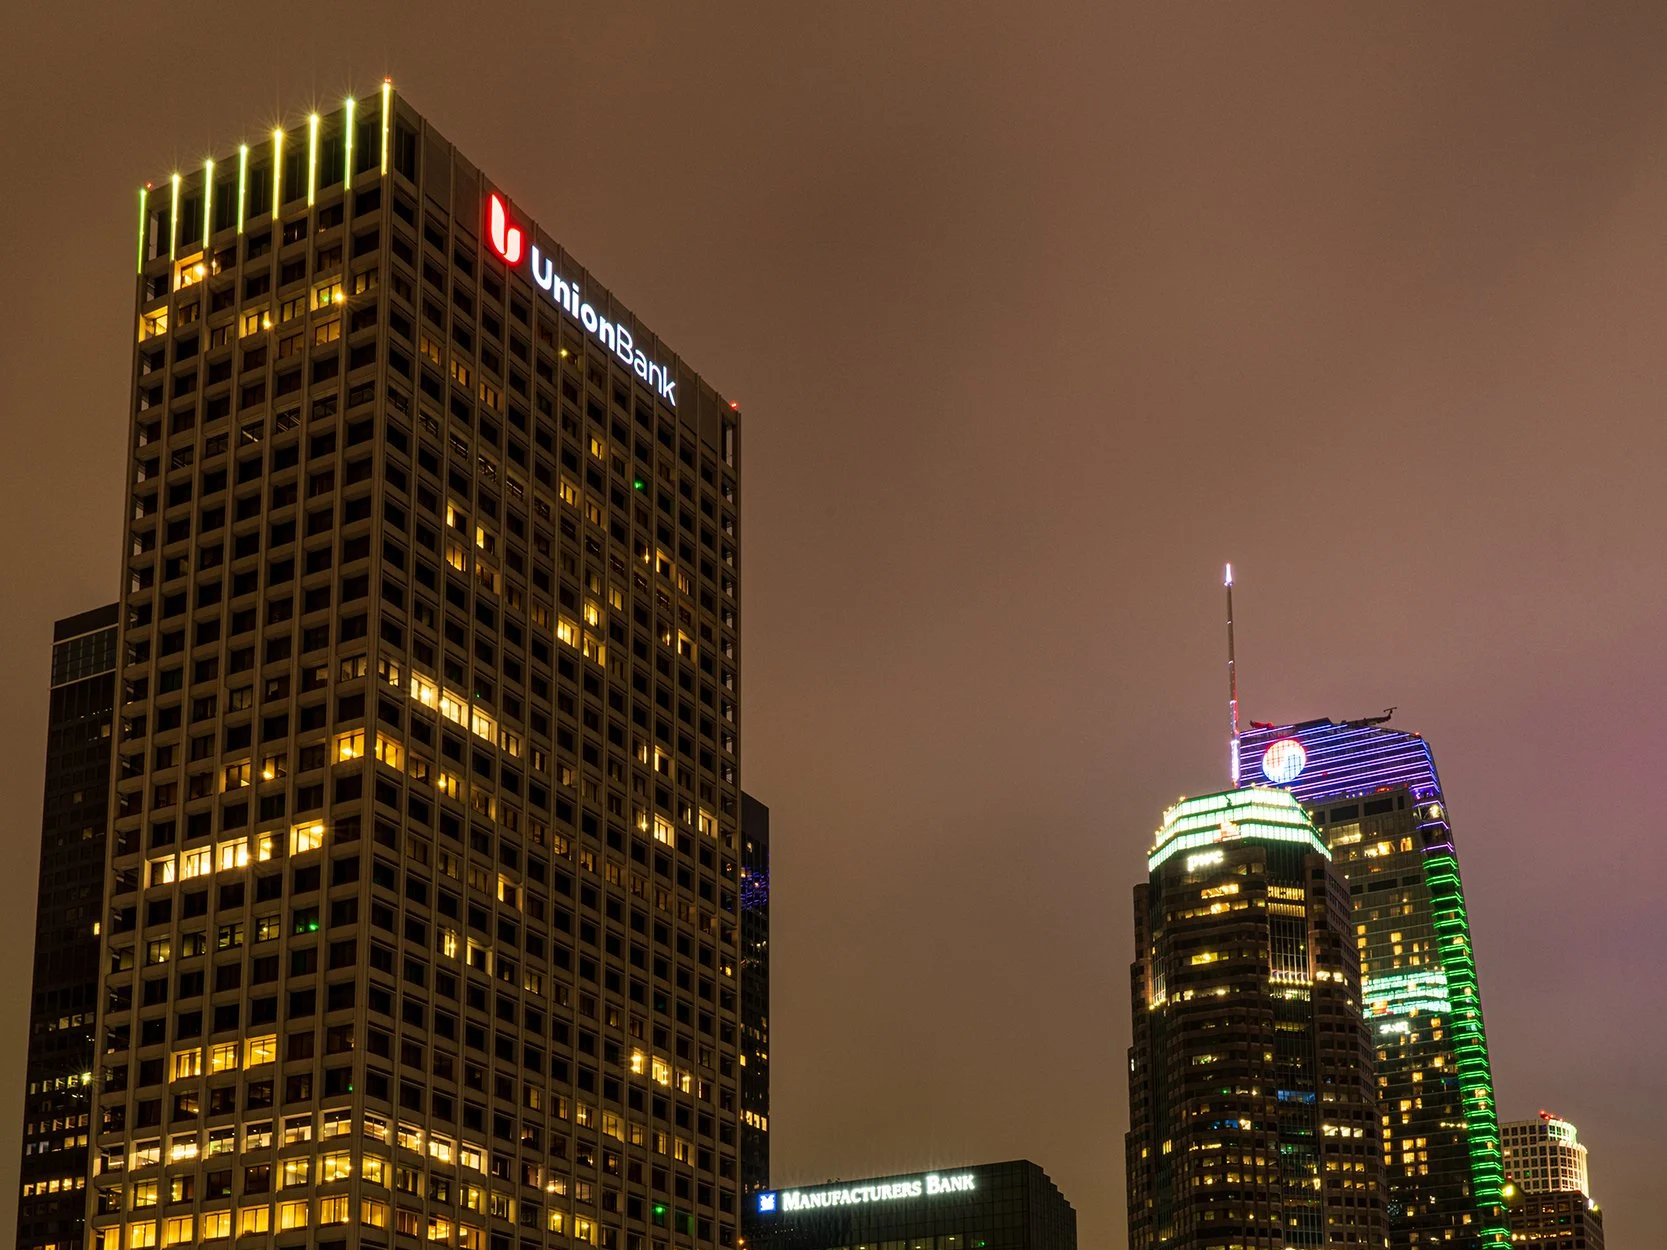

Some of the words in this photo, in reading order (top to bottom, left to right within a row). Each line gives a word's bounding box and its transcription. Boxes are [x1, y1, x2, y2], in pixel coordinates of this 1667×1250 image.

[531, 245, 676, 407] UnionBank
[782, 1180, 922, 1212] MANUFACTURERS
[925, 1174, 976, 1195] BANK
